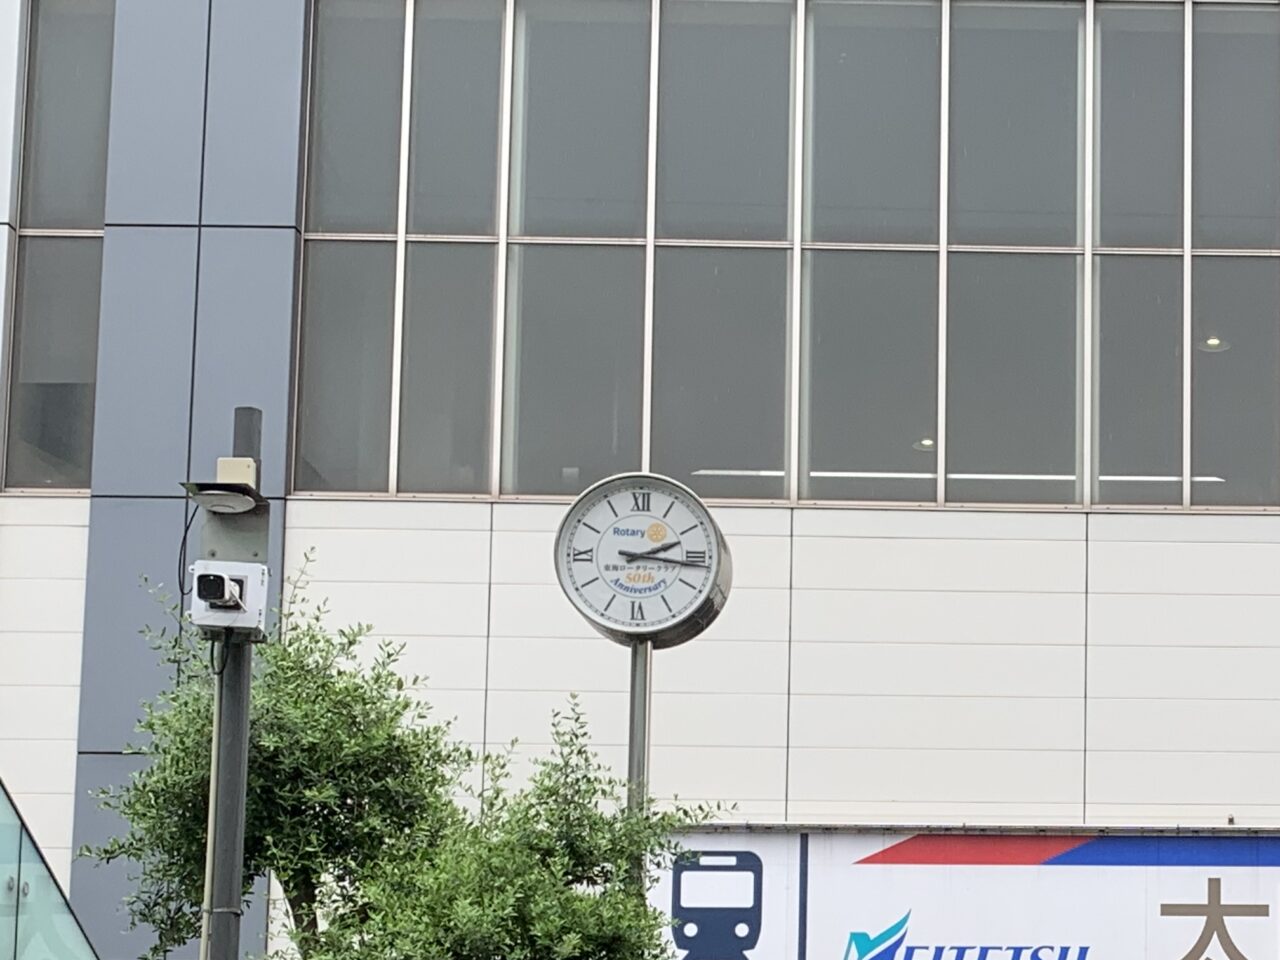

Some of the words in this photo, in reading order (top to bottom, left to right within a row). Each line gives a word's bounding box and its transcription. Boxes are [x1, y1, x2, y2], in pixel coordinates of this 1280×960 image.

[613, 527, 646, 538] Rotary
[625, 572, 656, 583] 50th
[610, 577, 668, 594] Anniversary
